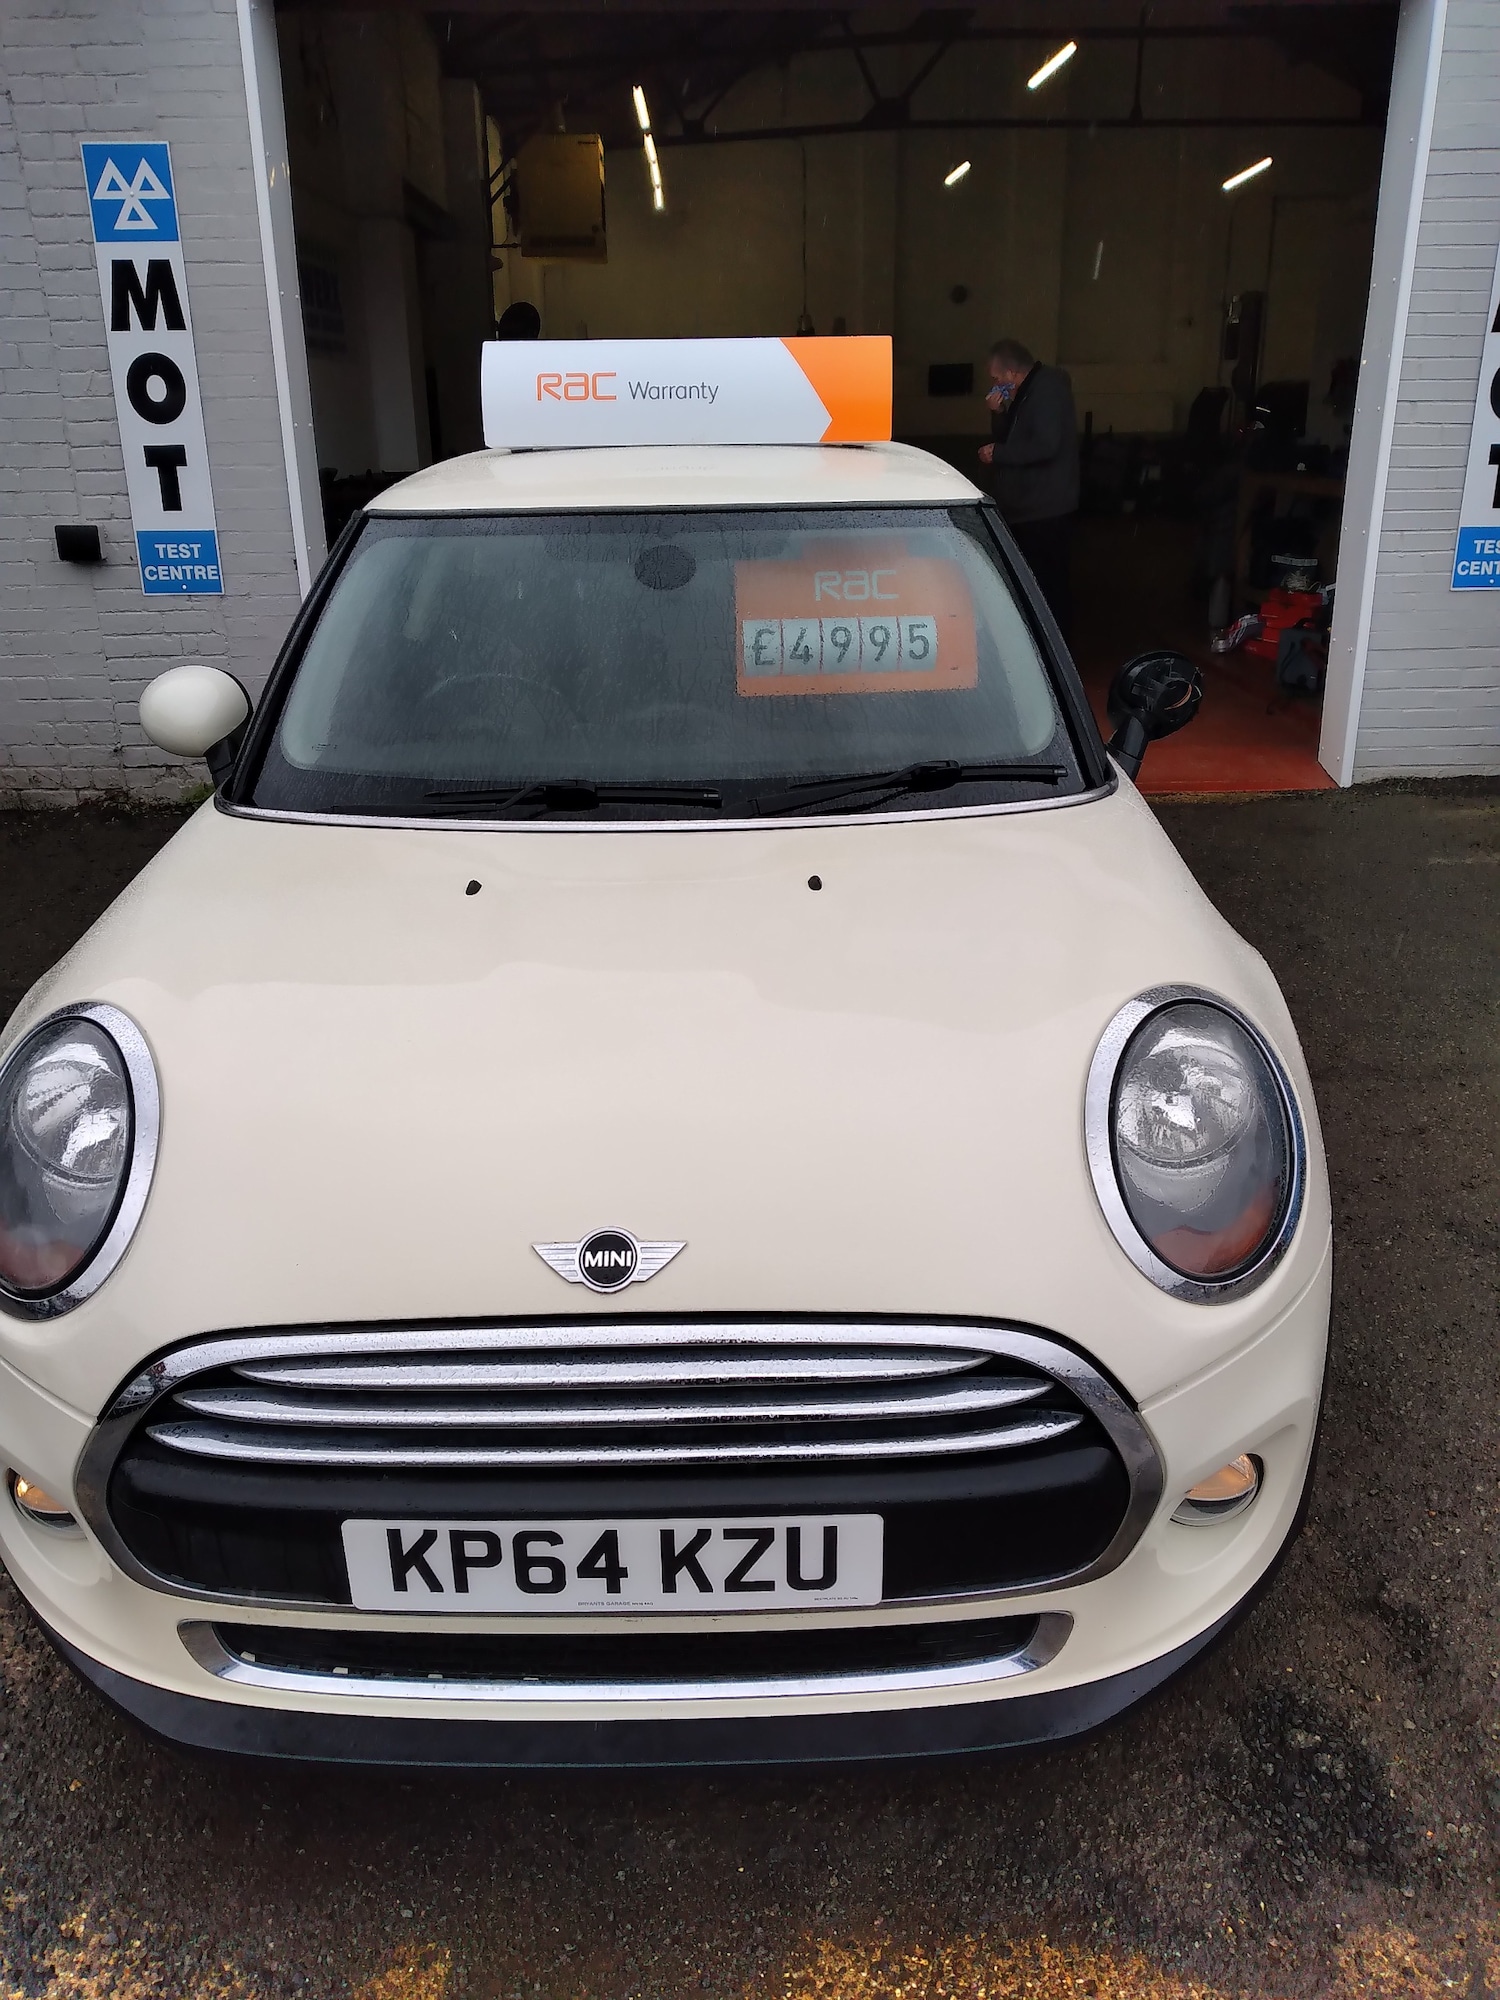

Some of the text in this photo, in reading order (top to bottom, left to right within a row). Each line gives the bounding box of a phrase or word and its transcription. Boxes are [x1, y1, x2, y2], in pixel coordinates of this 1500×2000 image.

[110, 258, 188, 512] MOT
[628, 381, 720, 404] Warranty
[154, 543, 201, 559] TEST
[144, 565, 219, 580] CENTRE
[752, 623, 931, 666] £4995
[584, 1250, 632, 1267] MINI
[385, 1525, 838, 1595] KP64 KZU
